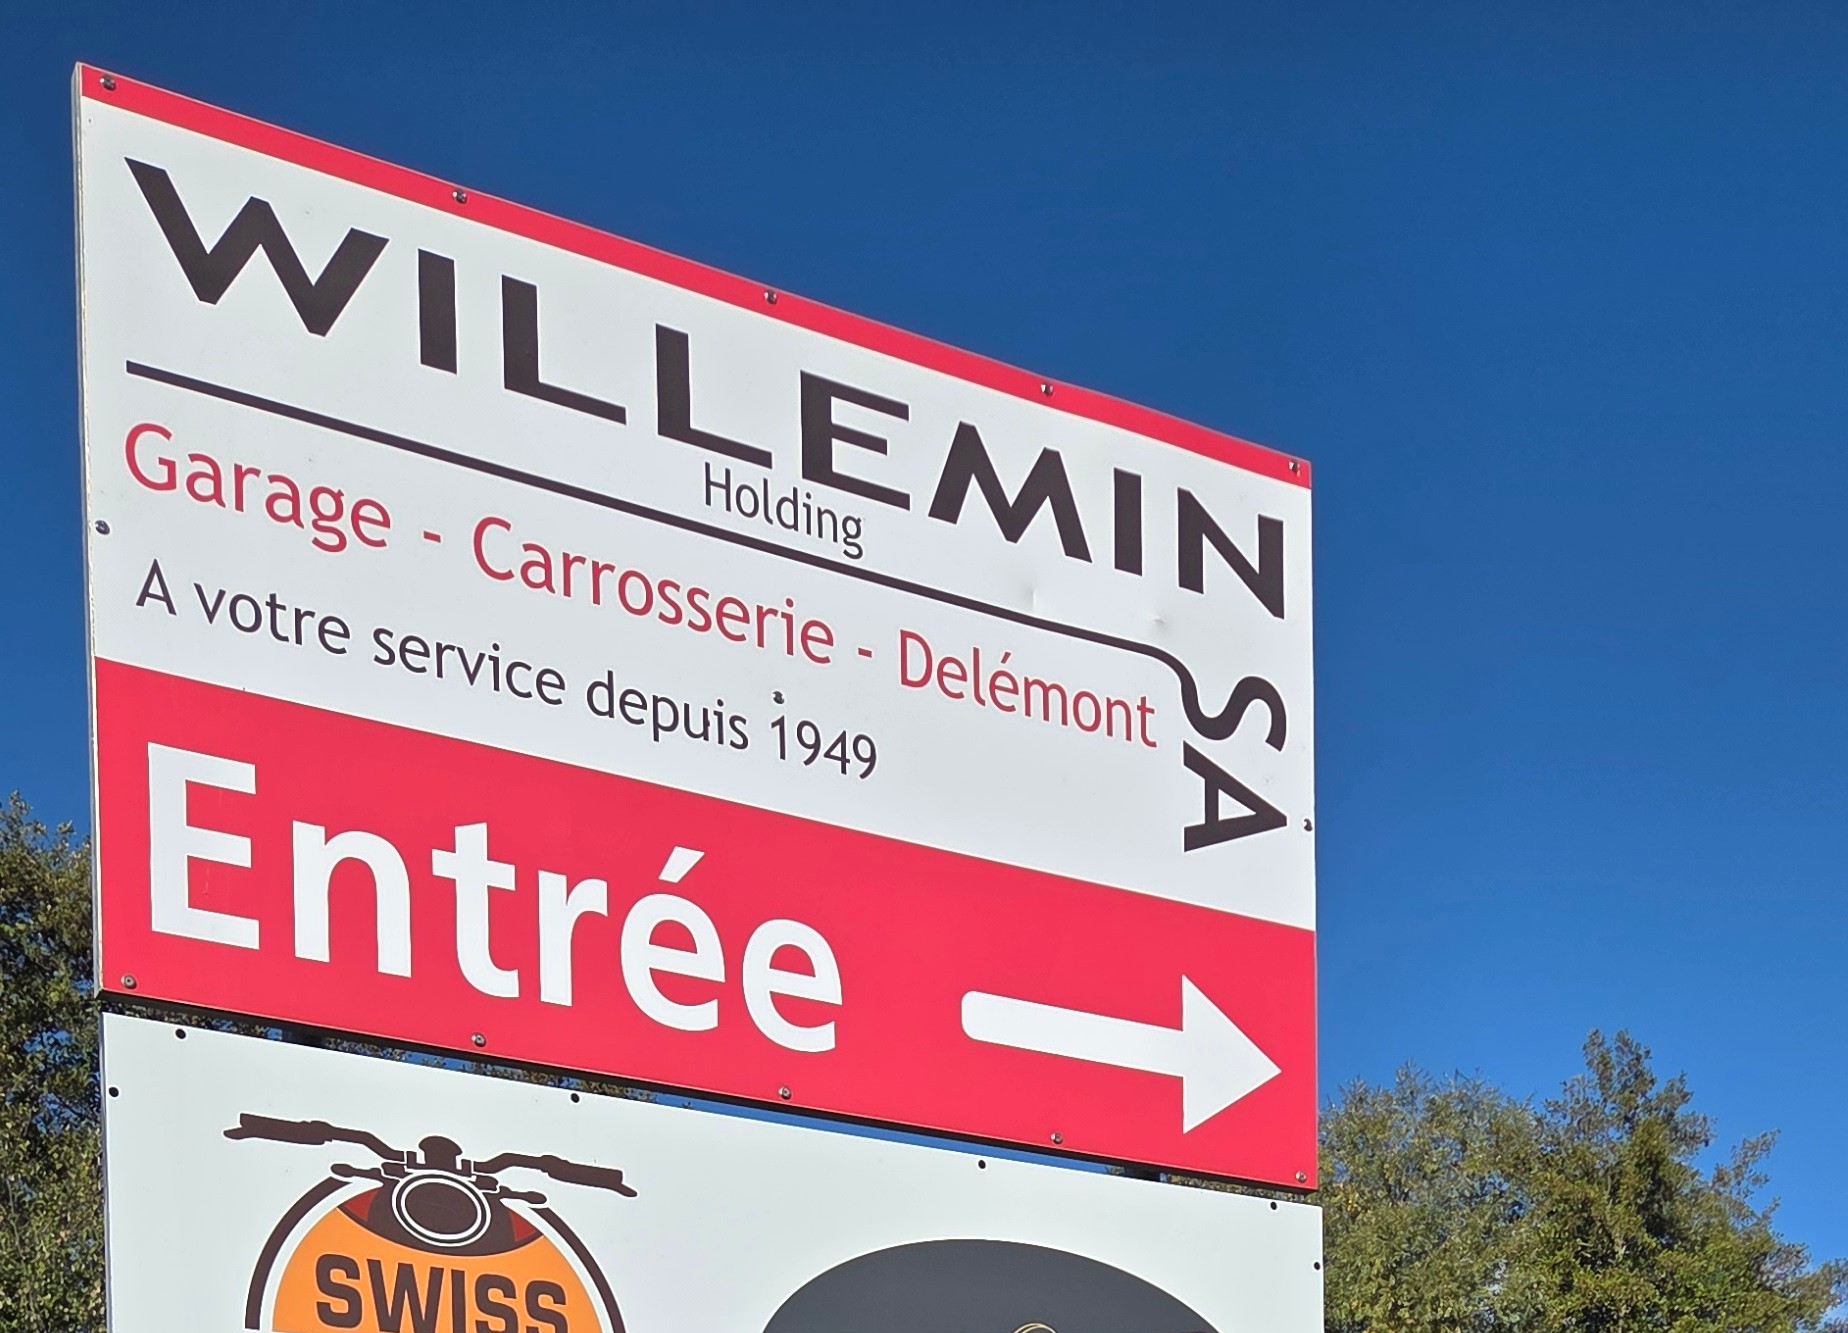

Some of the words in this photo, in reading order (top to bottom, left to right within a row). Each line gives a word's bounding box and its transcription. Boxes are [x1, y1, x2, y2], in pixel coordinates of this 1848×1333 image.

[124, 156, 1286, 620] WILLEMIN
[704, 461, 864, 560] Holding
[124, 422, 391, 554] Garage
[473, 516, 834, 665] Carrosserie
[899, 630, 1157, 748] Delémont
[135, 558, 177, 616] A
[193, 582, 351, 655] votre
[372, 627, 566, 706] service
[586, 669, 749, 750] depuis
[770, 714, 877, 780] 1949
[147, 741, 843, 1053] Entrée
[1181, 675, 1288, 853] SA
